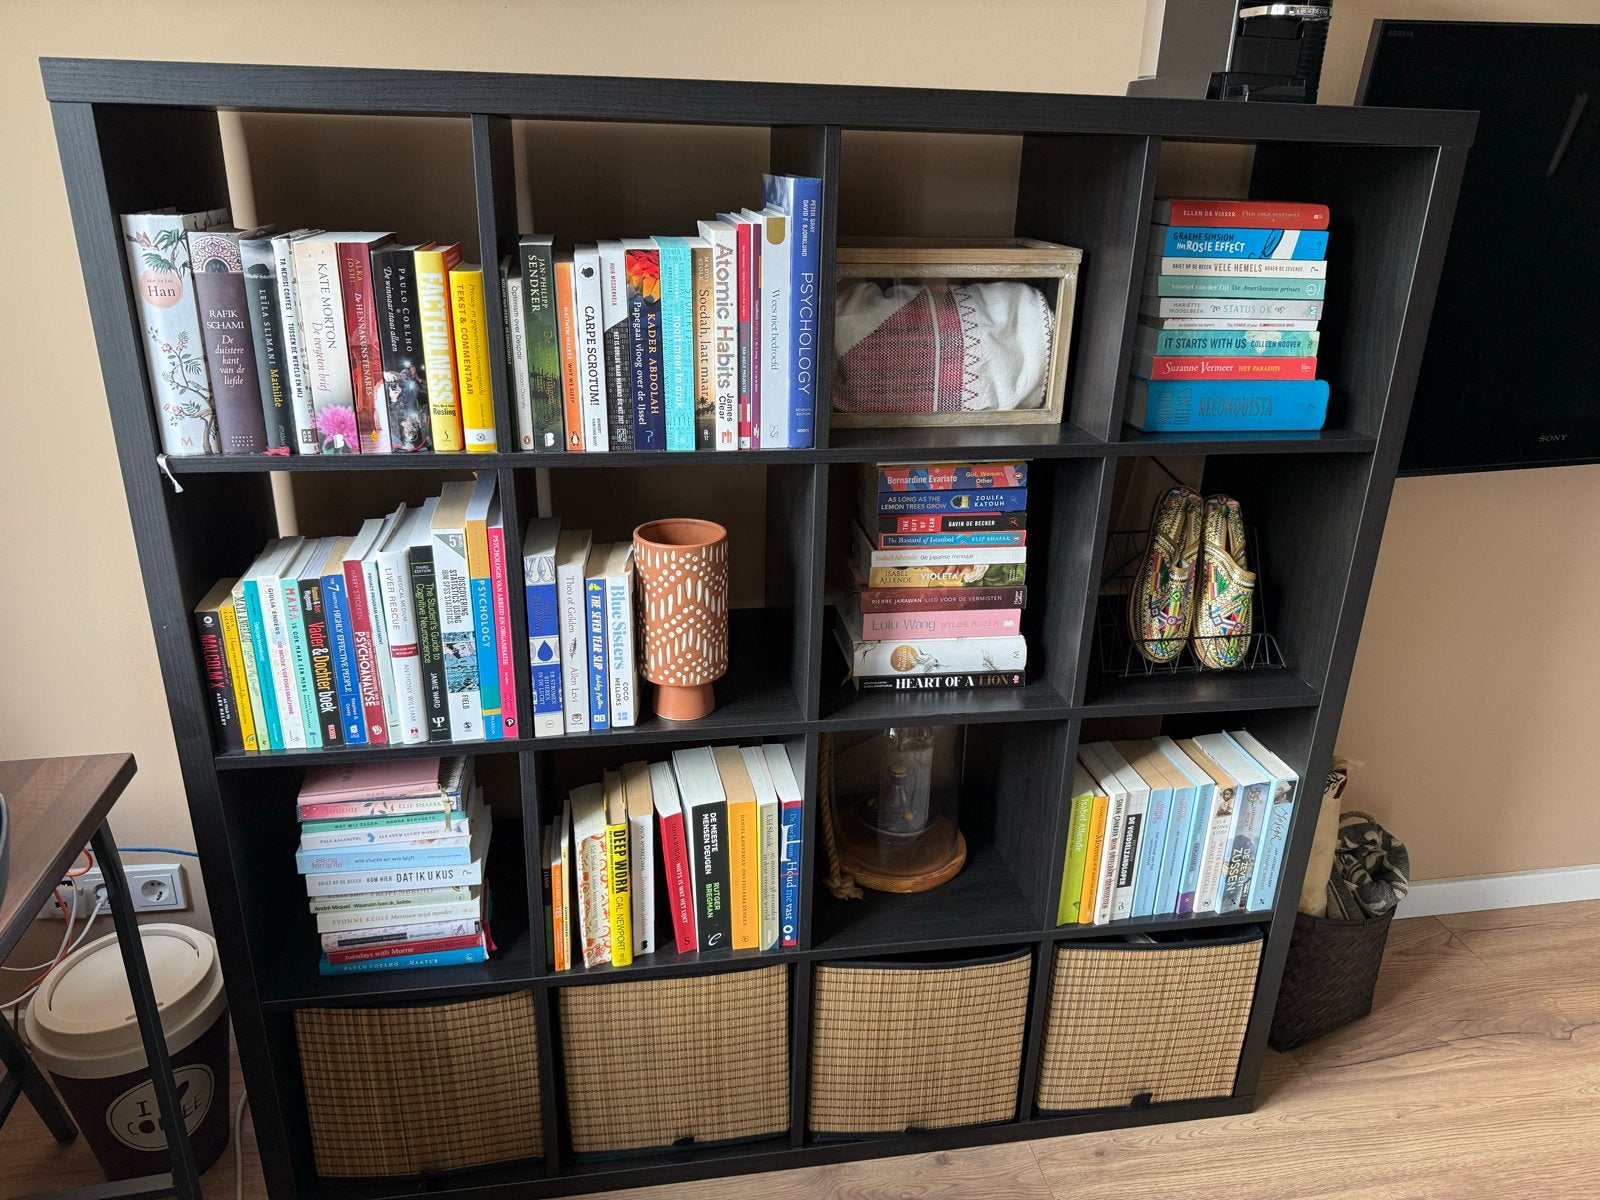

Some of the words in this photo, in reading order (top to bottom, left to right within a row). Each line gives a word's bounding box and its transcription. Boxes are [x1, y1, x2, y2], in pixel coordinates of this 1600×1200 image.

[1174, 232, 1202, 240] GRAEME
[1186, 241, 1212, 251] ROSIE
[1215, 242, 1245, 253] EFFECT
[318, 264, 330, 293] KATE
[1214, 263, 1231, 272] VELE
[1234, 264, 1262, 272] HEMELS
[148, 285, 176, 297] Han
[398, 268, 407, 302] PAULO
[527, 254, 541, 313] SENDKER
[538, 258, 548, 308] JAN-PHILIPP
[715, 244, 734, 319] Atomic
[209, 310, 238, 318] RAFIK
[699, 290, 711, 339] Soedah,
[1224, 305, 1256, 313] STATUS
[206, 321, 244, 329] SCHAMI
[321, 297, 336, 349] MORTON
[402, 308, 412, 352] COELHO
[585, 306, 595, 345] CARPE
[634, 302, 643, 340] Papegaai
[222, 335, 234, 344] De
[264, 322, 276, 365] SLIMANI
[420, 272, 454, 403] FACTFULNESS
[457, 285, 465, 314] TEKST
[461, 328, 474, 395] COMMENTAAR
[648, 313, 657, 353] KADER
[798, 272, 813, 395] PSYCHOLOGY
[1165, 339, 1173, 348] IT
[1176, 339, 1208, 349] STARTS
[1210, 339, 1233, 349] WITH
[1235, 339, 1246, 349] US
[1251, 340, 1276, 348] COLLEEN
[215, 346, 244, 355] duistere
[222, 356, 239, 365] kant
[635, 344, 644, 364] vloog
[674, 346, 682, 367] meer
[699, 342, 709, 363] laat
[717, 326, 734, 390] Habits
[236, 365, 245, 374] de
[587, 348, 599, 406] SCROTUM!
[676, 370, 682, 378] te
[1163, 362, 1198, 374] Suzanne
[1200, 361, 1233, 373] Vermeer
[224, 376, 243, 387] liefde
[270, 369, 281, 408] Mathilde
[637, 387, 644, 397] de
[650, 357, 659, 414] ABDOLAH
[700, 367, 710, 396] maar
[1538, 434, 1568, 443] SONY
[887, 477, 926, 485] Bernardine
[929, 475, 957, 484] Evaristo
[385, 568, 394, 593] LIVER
[390, 596, 400, 630] RESCUE
[416, 583, 425, 615] Cognitive
[425, 583, 434, 597] The
[457, 577, 469, 616] DISCOVERING
[591, 595, 600, 608] THE
[428, 598, 438, 629] Student's
[478, 580, 490, 647] PSYCHOLOGY
[611, 586, 625, 619] Blue
[272, 610, 280, 635] ENDERS
[592, 610, 601, 633] SEVEN
[872, 620, 898, 630] Lulu
[904, 620, 935, 631] Wang
[309, 622, 325, 648] Vader
[419, 616, 431, 663] Neuroscience
[431, 631, 439, 650] Guide
[593, 635, 602, 653] YEAR
[612, 621, 627, 669] Sisters
[202, 634, 223, 681] MALCOLM
[312, 647, 323, 656] &
[434, 651, 439, 660] to
[593, 654, 603, 669] SLIP
[314, 654, 331, 690] Dochter
[355, 632, 376, 706] PSYCHOANALYSE
[430, 672, 438, 689] JAMIE
[896, 678, 942, 689] HEART
[946, 677, 962, 688] OF
[965, 676, 974, 686] A
[978, 675, 1009, 686] LION
[319, 691, 334, 713] boek
[219, 709, 227, 726] HALEY
[710, 812, 716, 822] DE
[1129, 817, 1135, 825] DE
[613, 829, 626, 860] DEEP
[1119, 826, 1134, 886] VOEDSELZANDLOPER
[1243, 848, 1250, 859] DE
[396, 873, 414, 882] DAT
[416, 873, 425, 881] IK
[427, 872, 434, 880] U
[436, 870, 453, 879] KUS
[615, 861, 629, 893] WORK
[787, 862, 797, 888] Houd
[1226, 848, 1243, 891] ZUSSEN
[1237, 860, 1248, 887] ZEVEN
[615, 896, 624, 912] CAL
[713, 882, 721, 910] RUTGER
[787, 890, 793, 902] me
[617, 913, 626, 952] NEWPORT
[392, 947, 414, 955] Morrie
